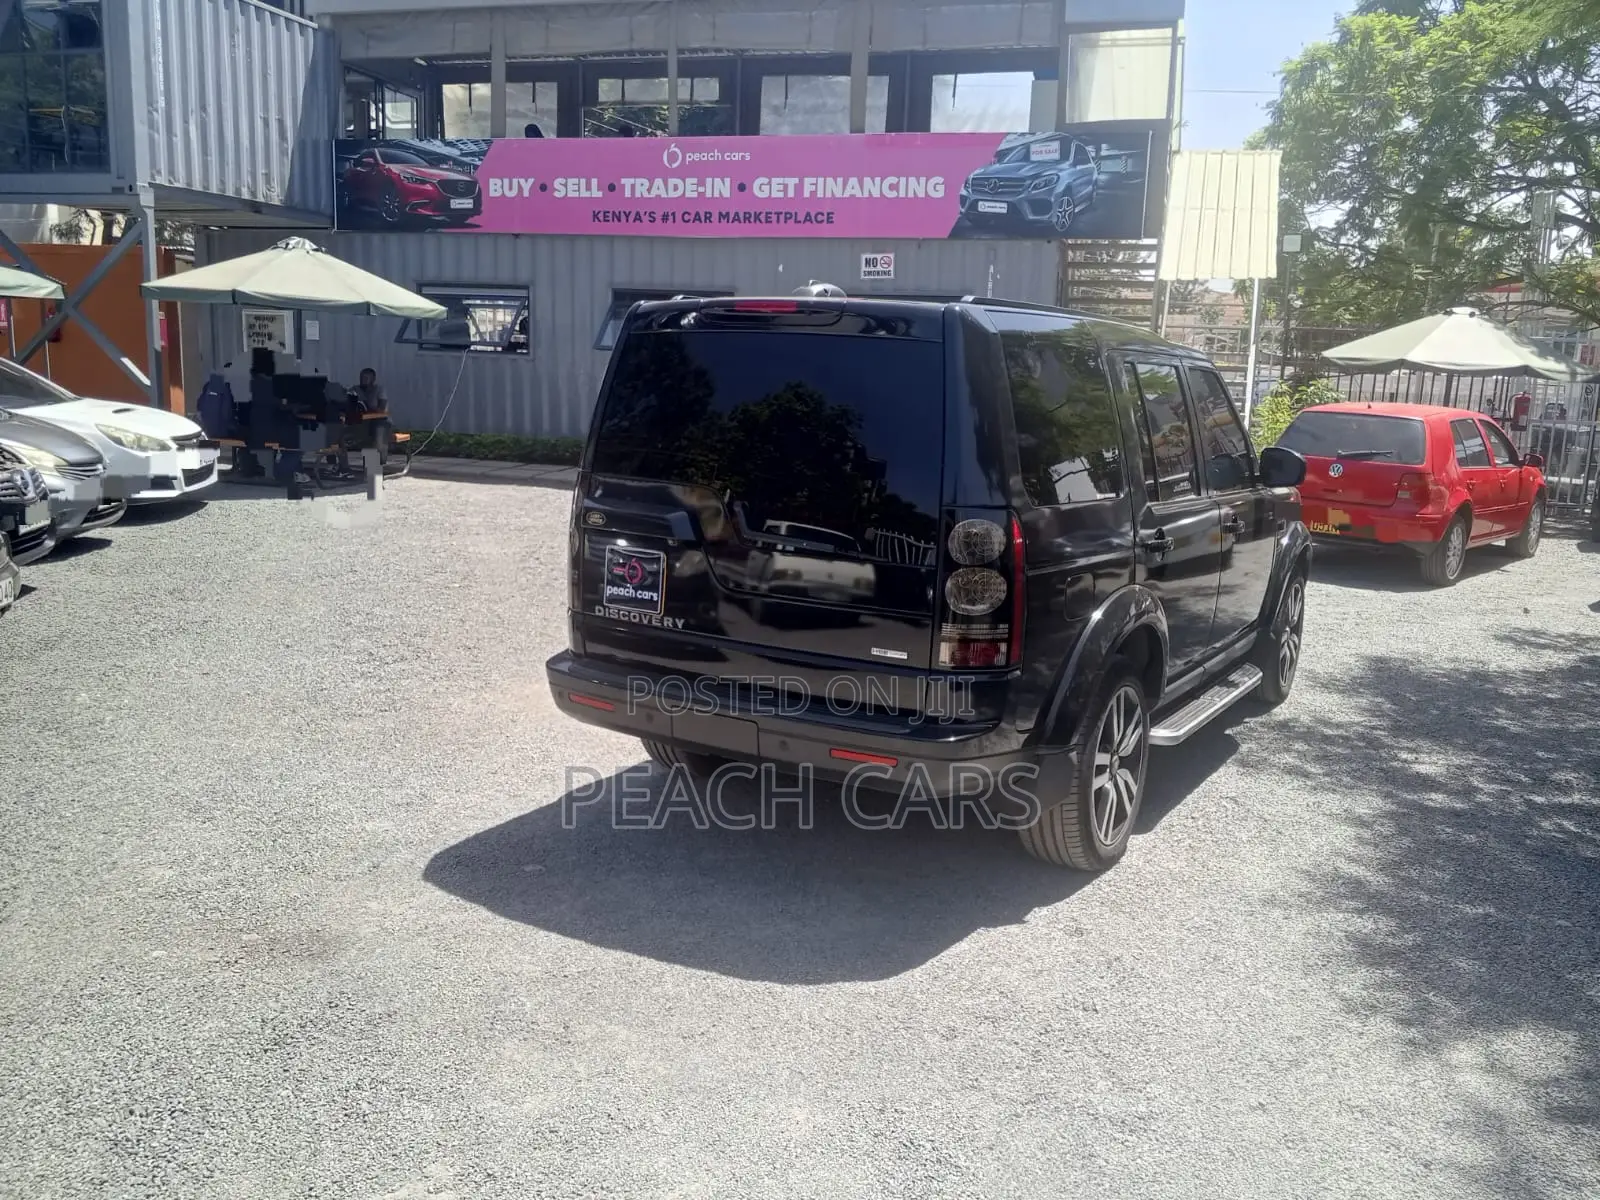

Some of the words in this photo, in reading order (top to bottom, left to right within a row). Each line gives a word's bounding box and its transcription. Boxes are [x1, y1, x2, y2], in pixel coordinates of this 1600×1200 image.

[686, 149, 722, 165] peach
[724, 152, 751, 161] cars
[488, 177, 535, 198] BUY
[553, 177, 603, 198] SELL
[621, 177, 731, 198] TRADE-IN
[752, 176, 799, 198] GET
[803, 176, 945, 198] FINANCING
[592, 210, 657, 224] KENYA'S
[661, 211, 676, 224] #1
[681, 211, 713, 224] CAR
[718, 211, 835, 224] MARKETPLACE
[864, 257, 878, 268] NO
[606, 584, 636, 597] peach
[636, 589, 658, 601] cars
[594, 605, 685, 629] DISCOVERY
